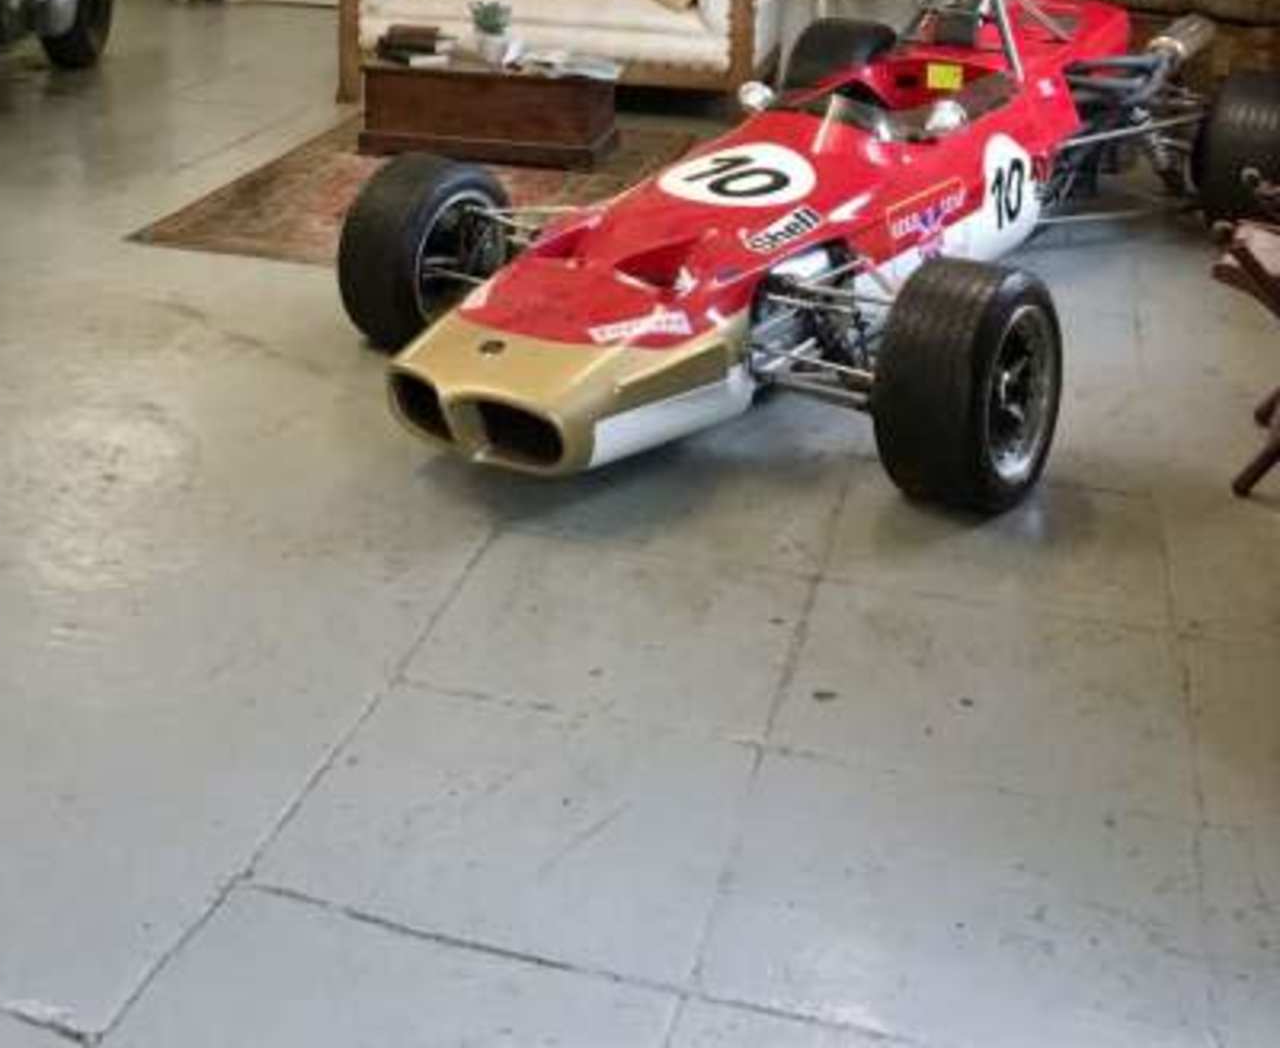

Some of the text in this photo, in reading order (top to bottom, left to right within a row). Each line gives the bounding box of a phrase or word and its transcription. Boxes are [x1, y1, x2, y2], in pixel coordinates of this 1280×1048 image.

[683, 156, 790, 198] 10
[991, 158, 1026, 229] 10
[749, 208, 821, 251] Shell
